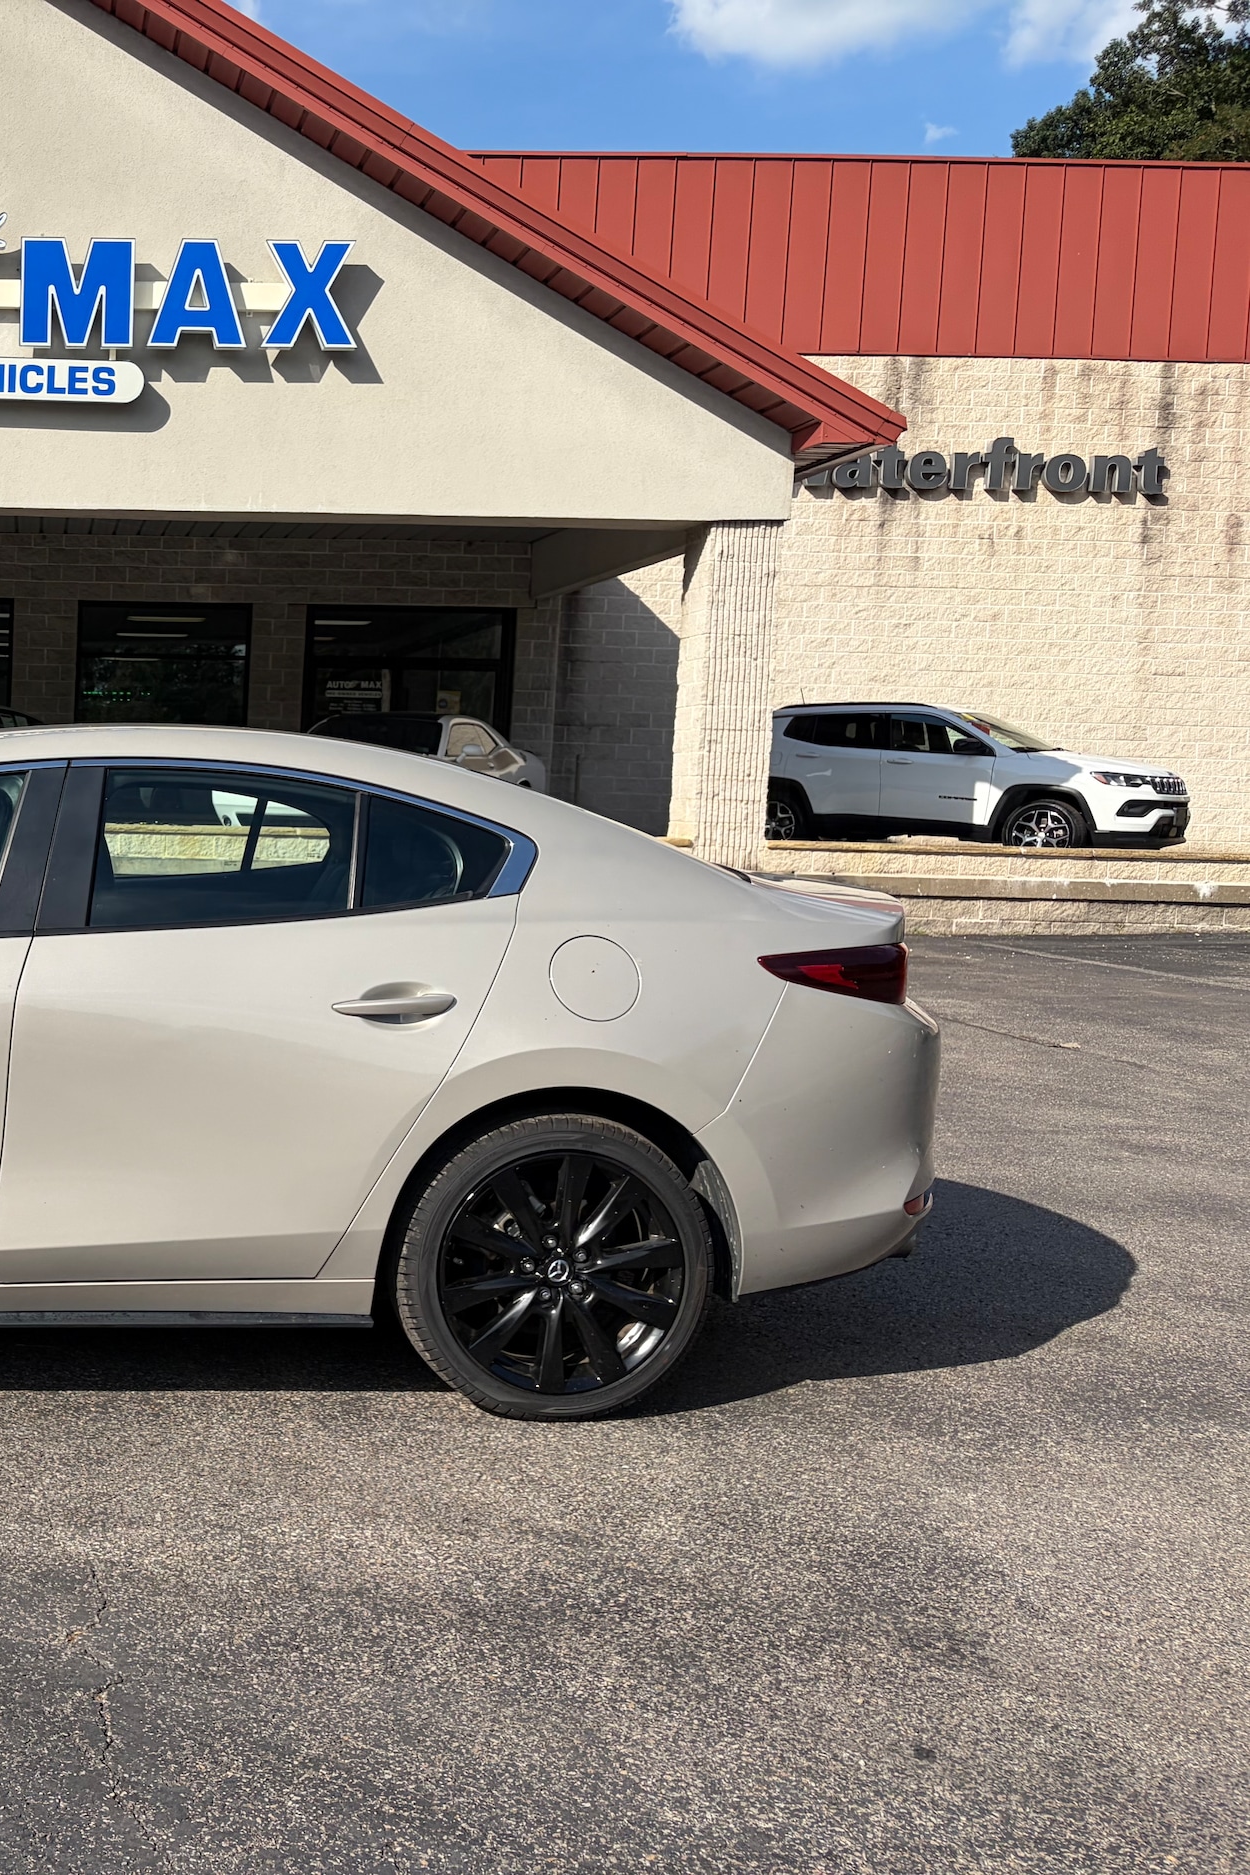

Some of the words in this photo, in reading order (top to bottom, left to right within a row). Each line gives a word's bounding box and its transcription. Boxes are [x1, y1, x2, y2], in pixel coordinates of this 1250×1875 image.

[19, 237, 358, 351] MAX
[802, 437, 1167, 495] aterfront
[326, 680, 352, 689] AUTO
[360, 681, 382, 689] MAX
